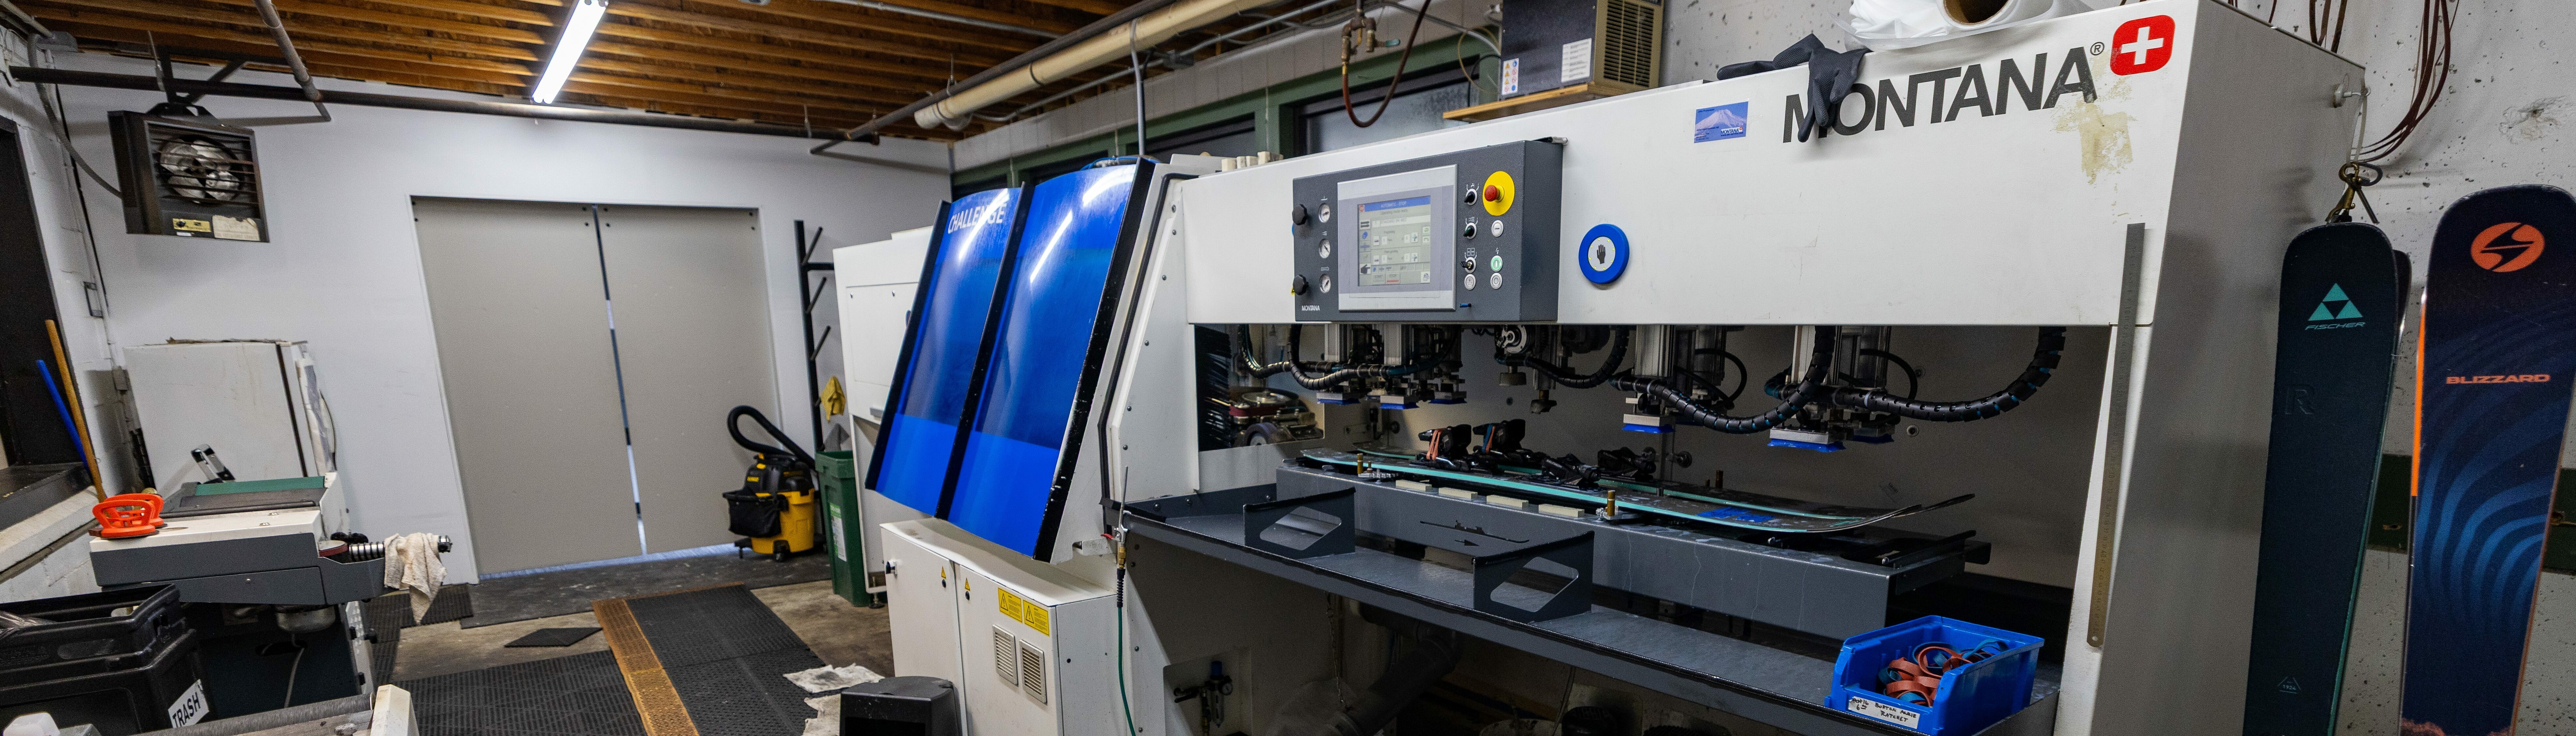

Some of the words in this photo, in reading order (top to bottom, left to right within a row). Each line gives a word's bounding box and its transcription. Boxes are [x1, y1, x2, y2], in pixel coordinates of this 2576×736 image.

[2305, 322, 2366, 330] FISCHER
[2447, 374, 2551, 384] BLIZZARD
[1546, 459, 1563, 468] SALOMON
[172, 691, 201, 728] TRASH
[1880, 710, 1908, 722] RATCHET
